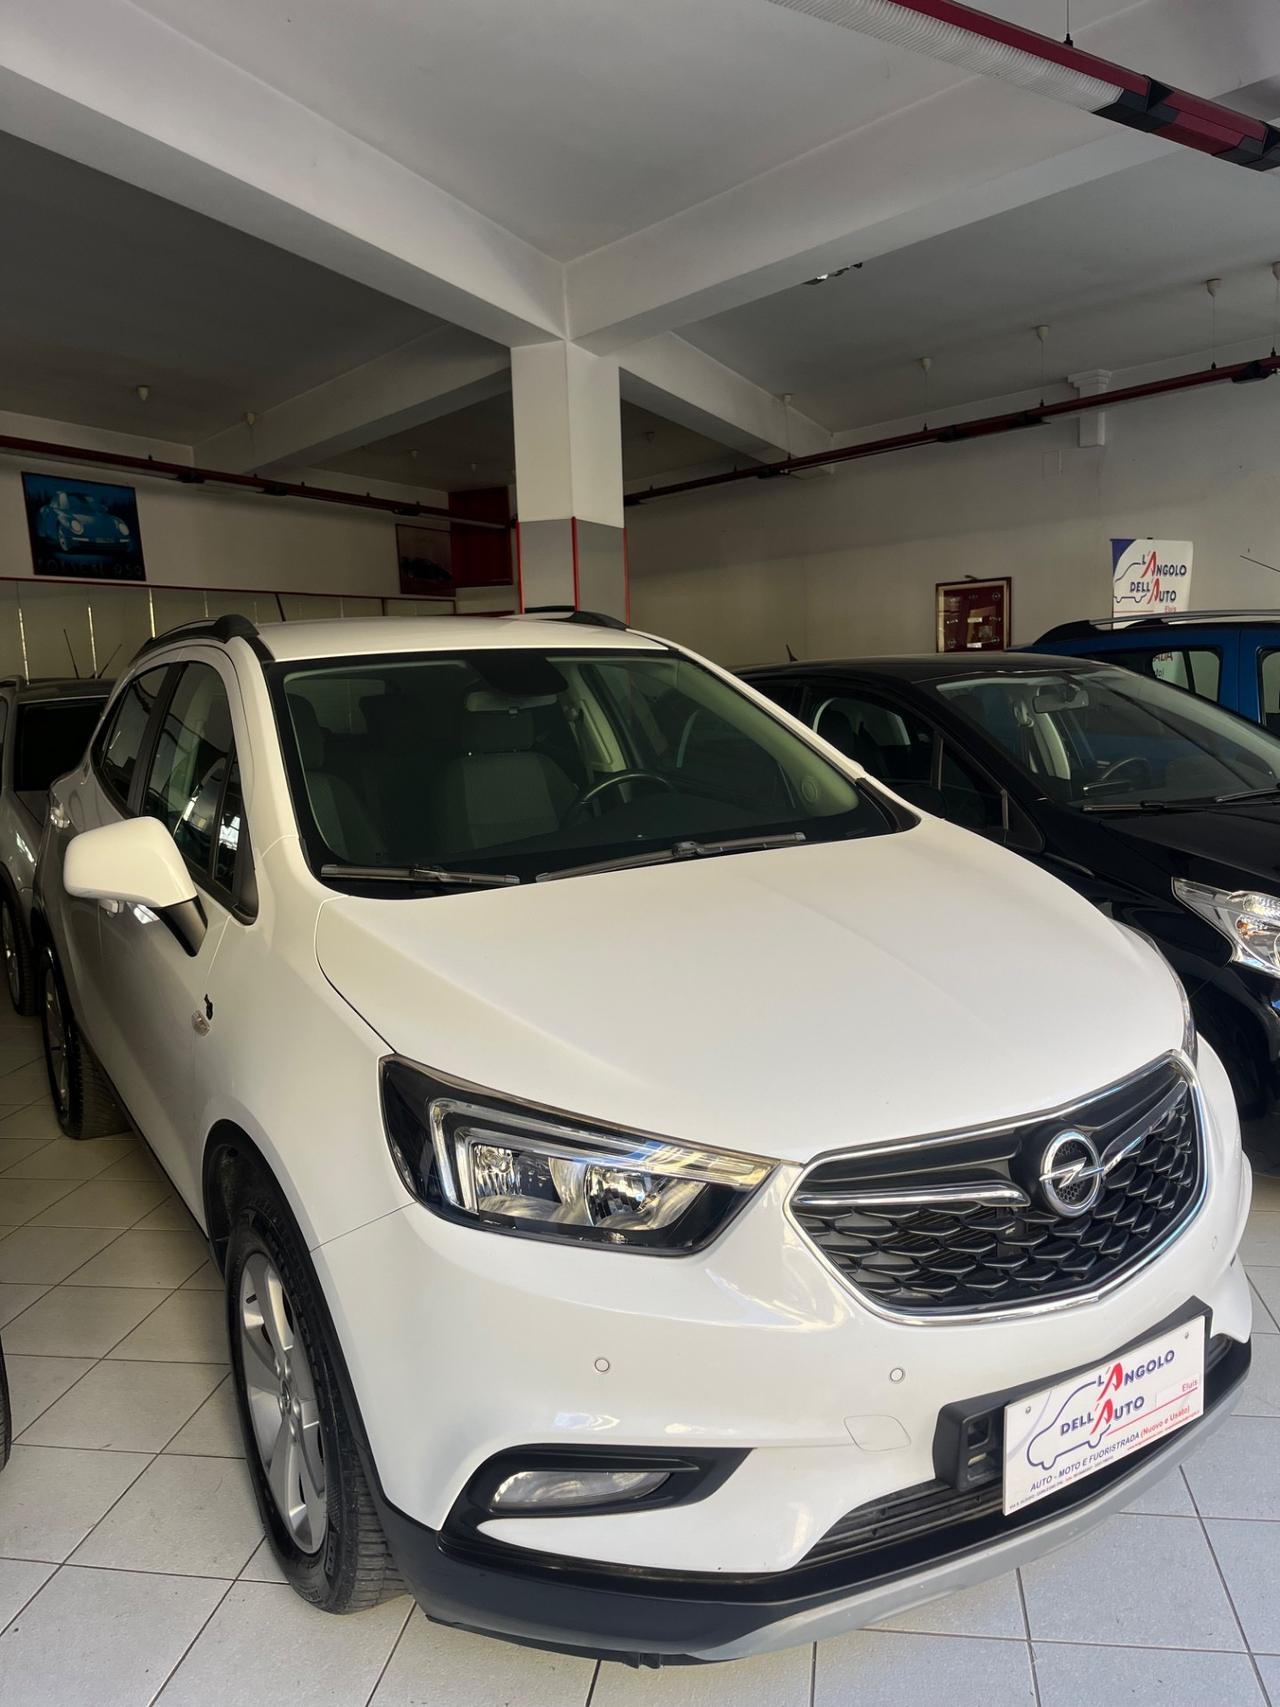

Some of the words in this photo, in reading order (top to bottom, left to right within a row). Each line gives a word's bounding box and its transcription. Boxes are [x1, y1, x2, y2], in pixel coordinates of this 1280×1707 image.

[1140, 550, 1187, 578] L'ANGOLO
[1130, 577, 1177, 605] DELL'AUTO
[1096, 1349, 1175, 1401] L'ANGOLO
[1060, 1395, 1145, 1436] DELL'AUTO
[1030, 1475, 1053, 1491] AUTO
[1058, 1461, 1081, 1478] MOTO
[1082, 1457, 1089, 1466] E
[1088, 1431, 1140, 1464] FUORISTRADA
[1140, 1421, 1163, 1438] (Nuovo
[1169, 1404, 1190, 1421] Usato)
